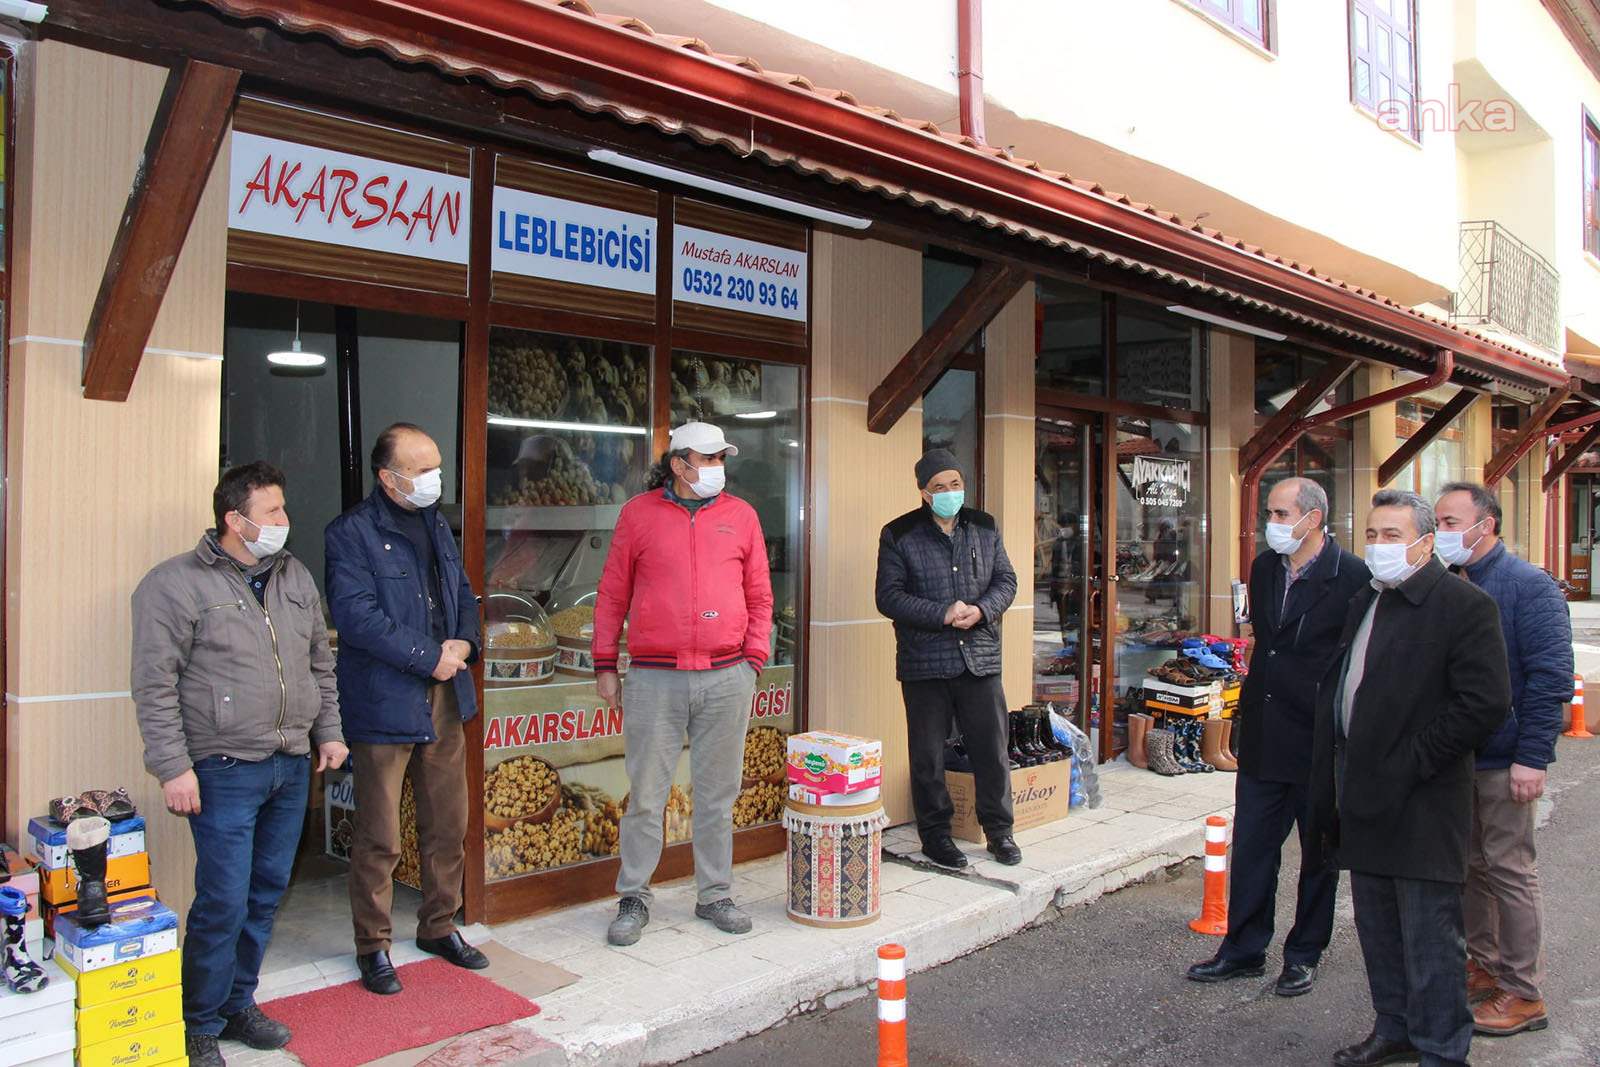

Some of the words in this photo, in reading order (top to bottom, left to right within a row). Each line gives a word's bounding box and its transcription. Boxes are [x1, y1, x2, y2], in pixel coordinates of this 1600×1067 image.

[238, 154, 461, 243] AKARSLAN
[681, 241, 732, 265] Mustafa
[733, 252, 799, 278] AKARSLAN
[683, 267, 722, 296] 0532
[727, 276, 754, 302] 230
[759, 282, 777, 306] 93
[781, 286, 798, 310] 64
[1131, 456, 1191, 492] AYAKKABICI
[484, 706, 624, 750] AKARSLAN
